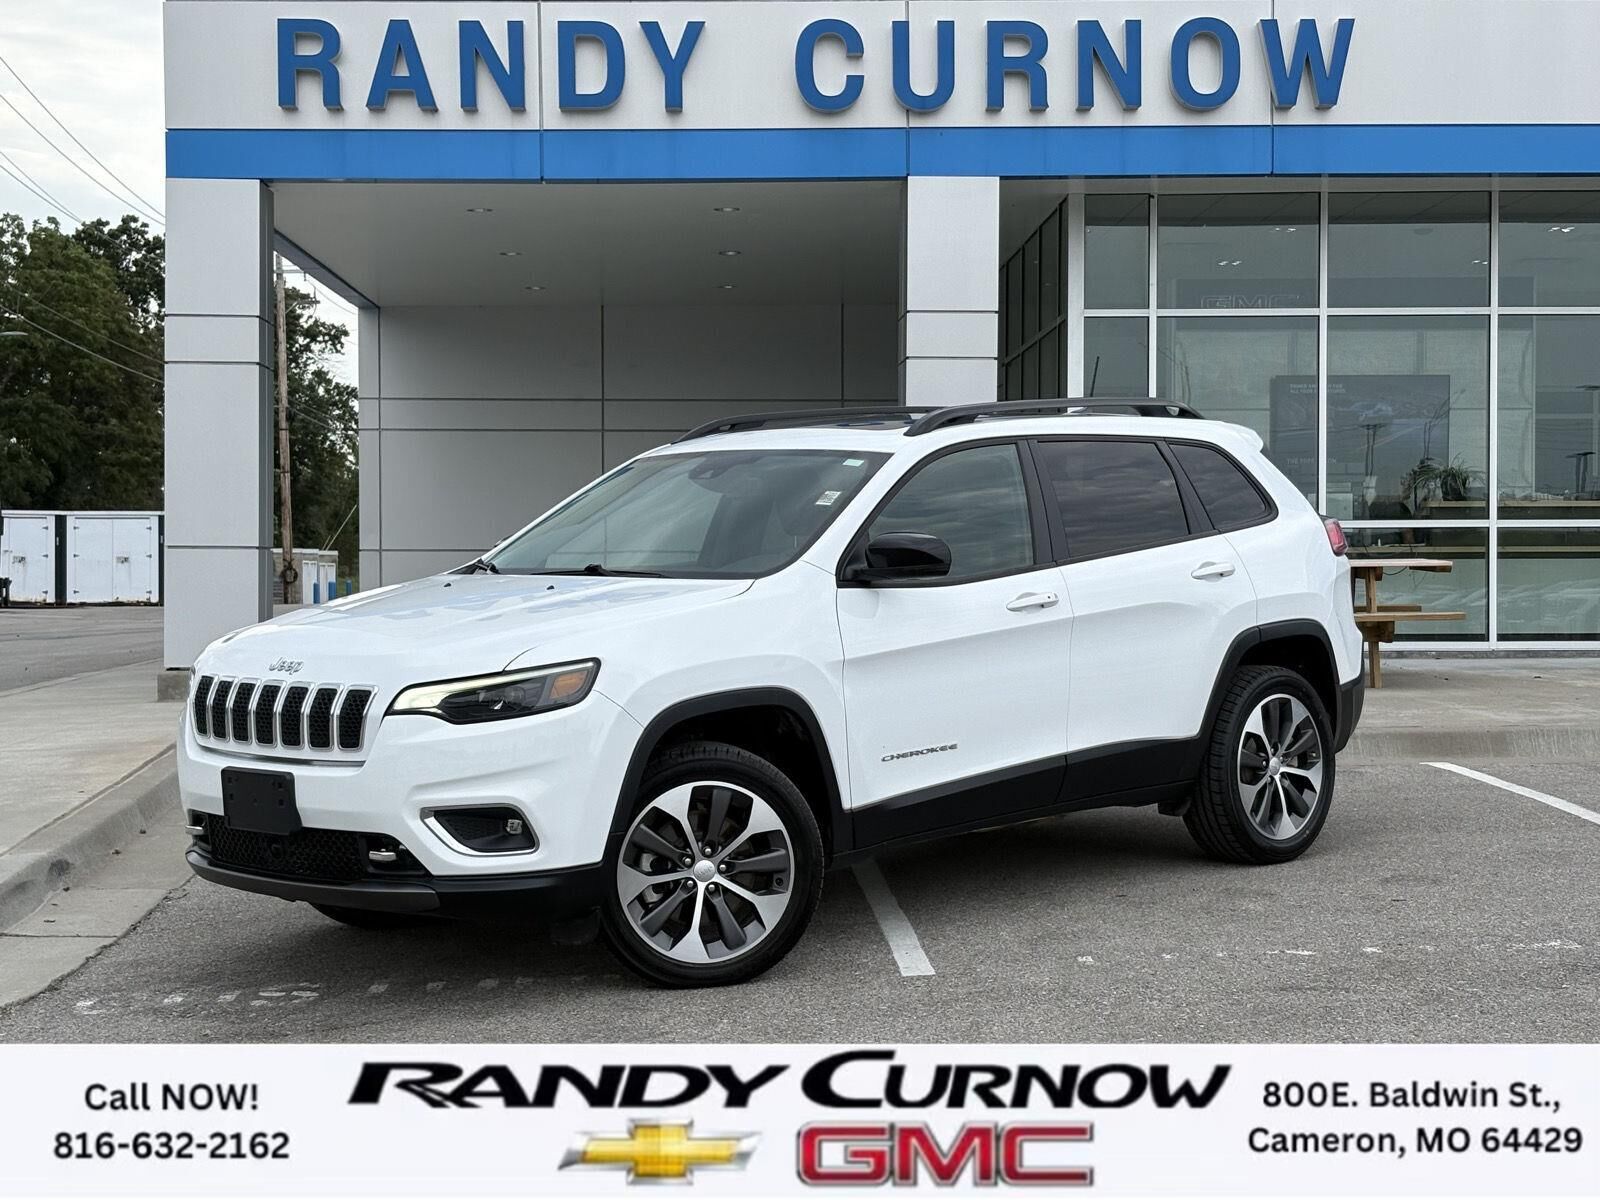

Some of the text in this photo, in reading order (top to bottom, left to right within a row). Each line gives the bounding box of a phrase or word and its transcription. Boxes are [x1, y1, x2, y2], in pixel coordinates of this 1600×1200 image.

[278, 17, 1355, 113] RANDY CURNOW
[269, 657, 304, 675] Jeep
[881, 743, 958, 762] CHEROKEE
